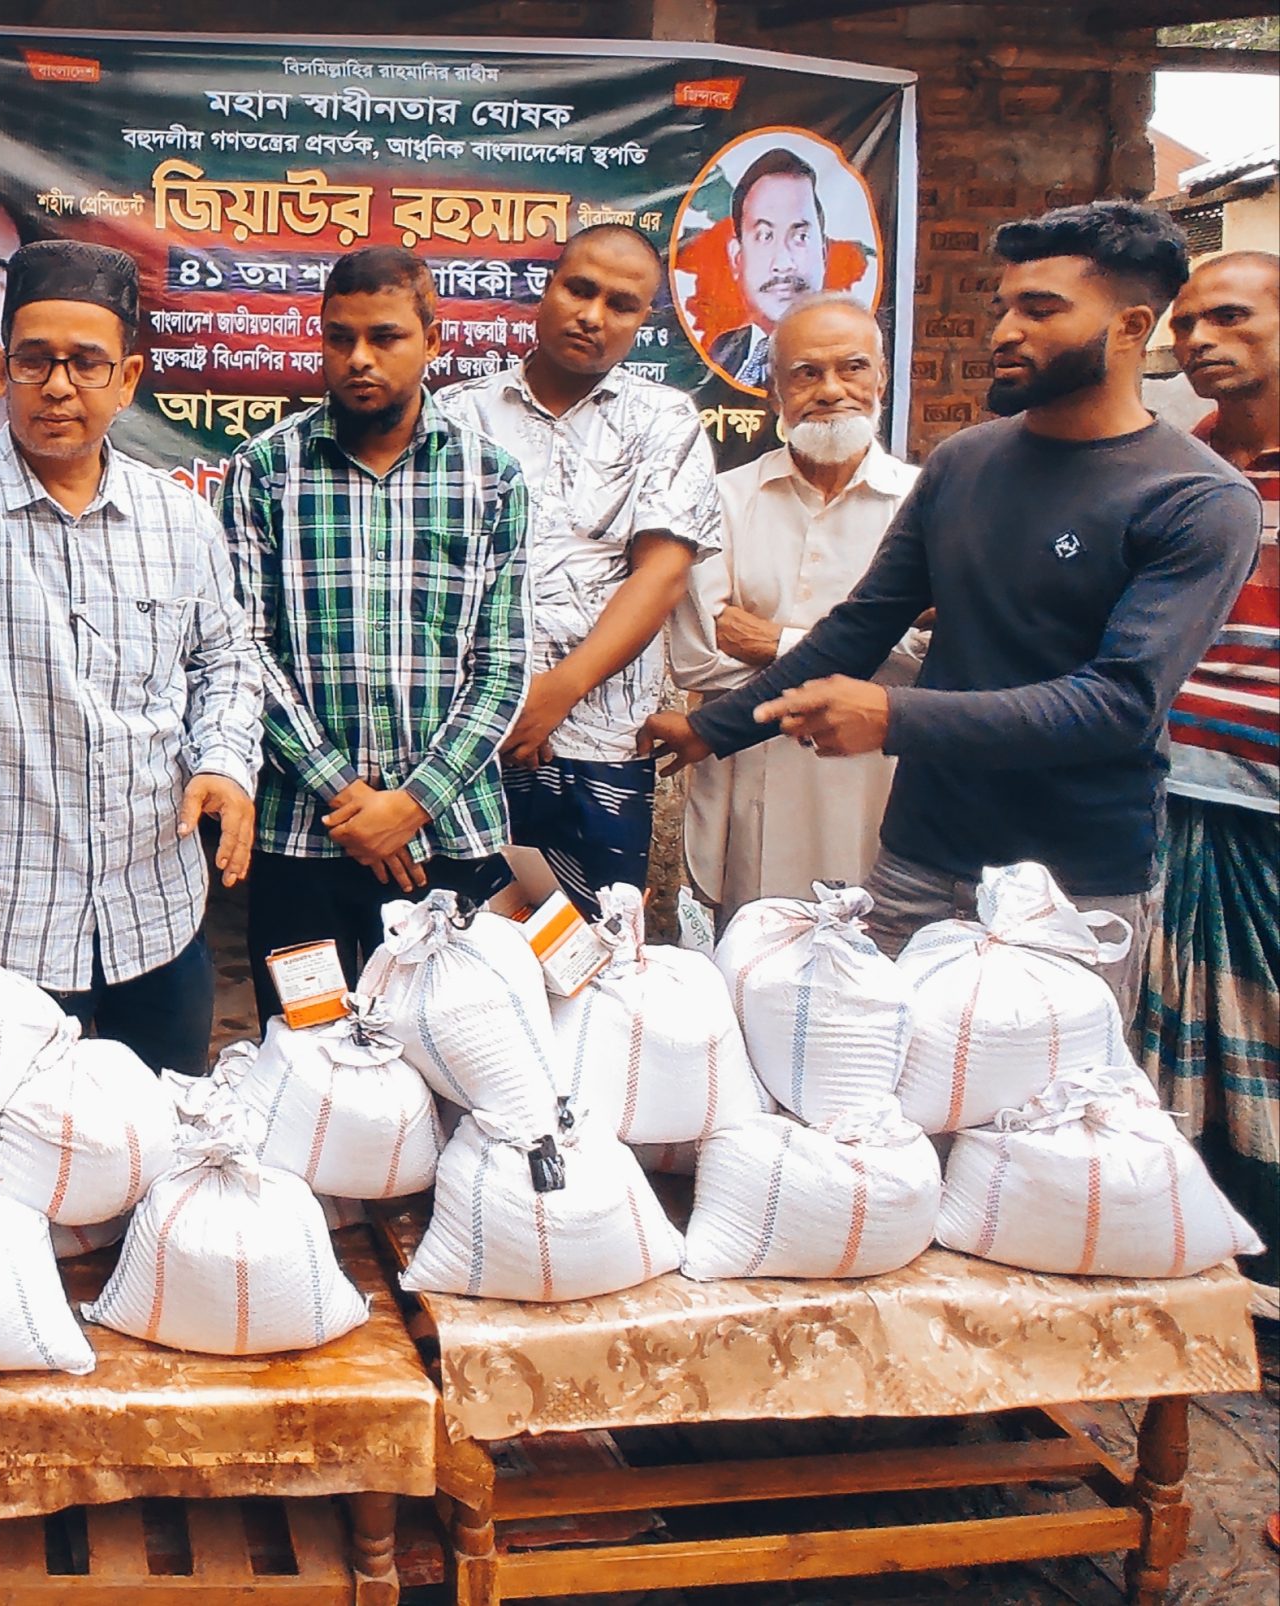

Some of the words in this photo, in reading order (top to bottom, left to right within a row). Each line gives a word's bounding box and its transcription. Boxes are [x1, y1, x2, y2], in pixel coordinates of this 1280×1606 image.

[283, 57, 373, 79] বিসমিল্লাহির
[378, 61, 449, 81] রাহমানির
[454, 63, 501, 84] রাহীম
[205, 89, 293, 121] মহান
[299, 86, 462, 126] স্বাধীনতার
[471, 99, 575, 130] ঘোষক
[121, 123, 205, 152] বহুদলীয়
[210, 129, 301, 154] গণতন্ত্রের
[304, 129, 380, 160] প্রবর্তক,
[385, 133, 466, 163] আধুনিক
[470, 138, 586, 165] বাংলাদেশের
[590, 142, 649, 169] স্থপতি
[36, 186, 74, 217] শহীদ
[78, 191, 145, 218] প্রেসিডেন্ট
[152, 158, 374, 246] জিয়াউর
[391, 187, 572, 248] রহমান
[638, 210, 663, 231] এর
[179, 260, 224, 288] ৪১
[234, 262, 292, 290] তম
[431, 260, 518, 297] ার্ষিকী
[150, 308, 214, 335] বাংলাদেশ
[217, 305, 303, 336] জাতীয়তাবাদী
[150, 341, 208, 374] যুক্তরাষ্ট্র
[213, 342, 287, 371] বিএনপির
[153, 389, 291, 440] আবুল
